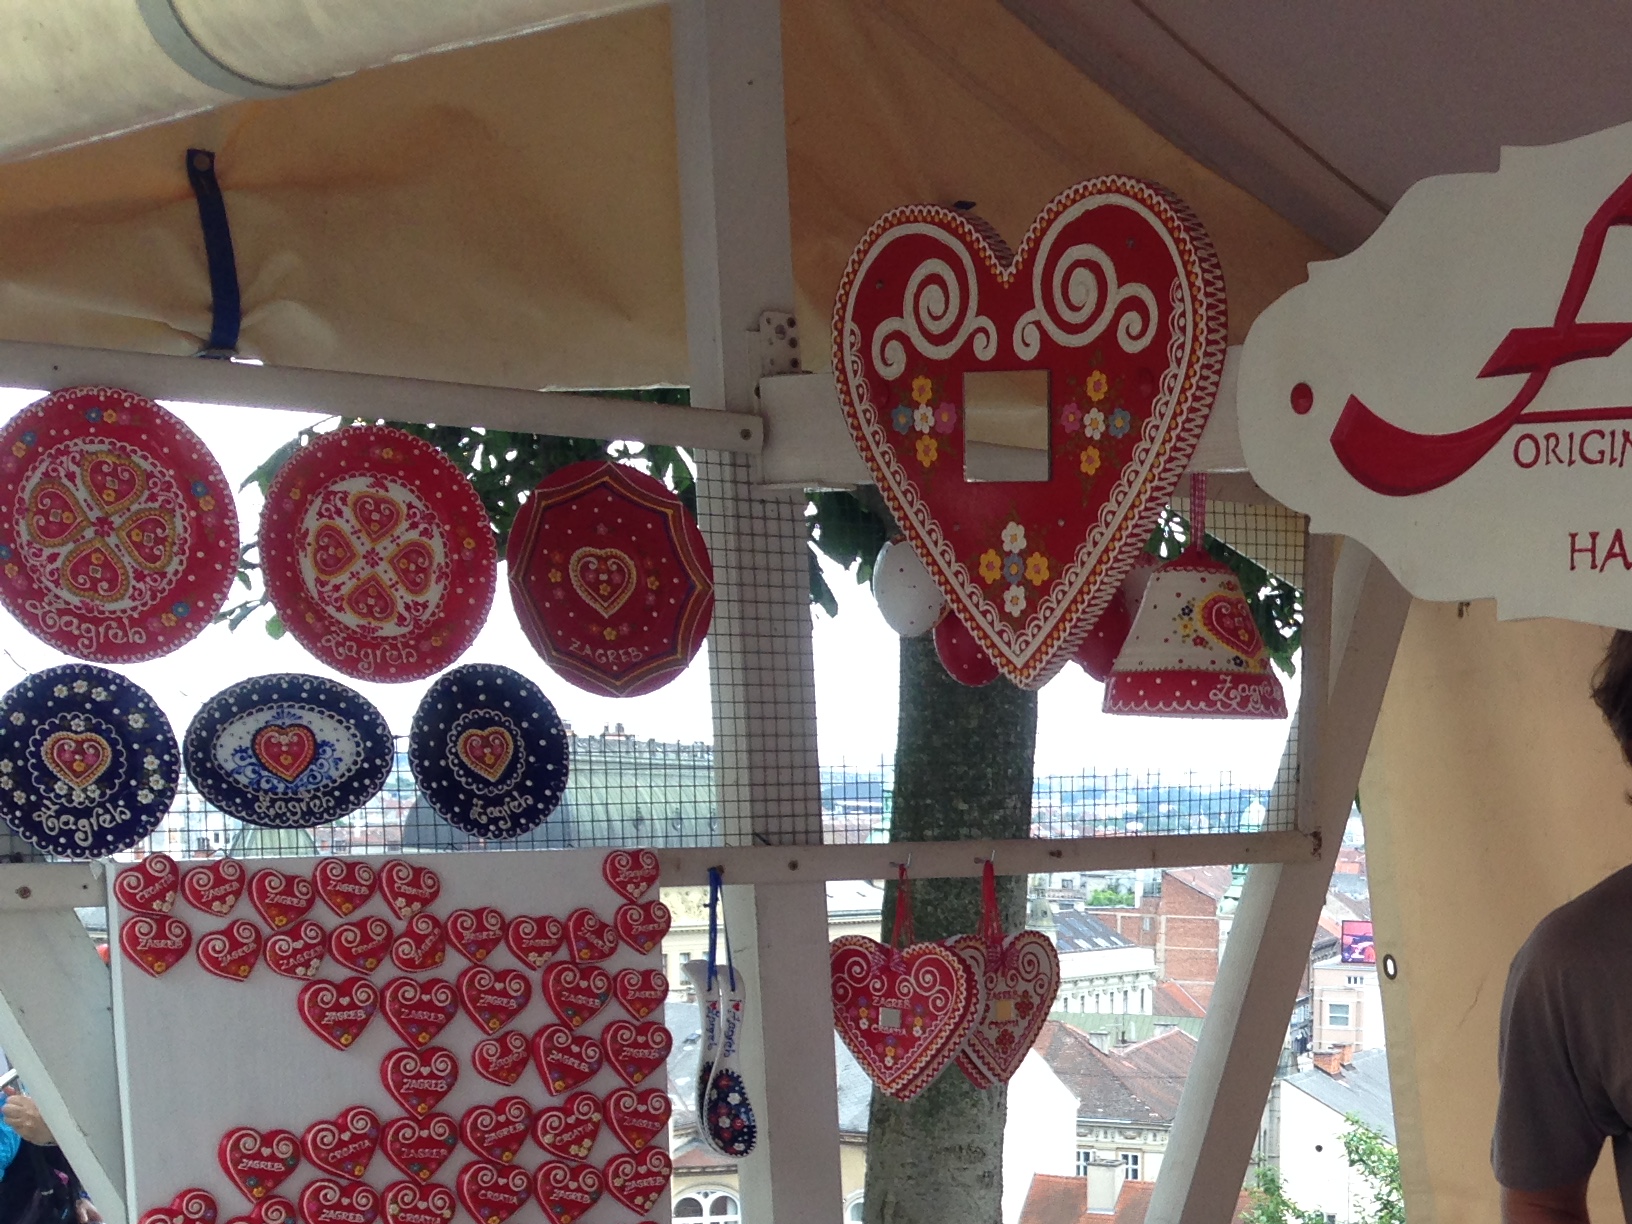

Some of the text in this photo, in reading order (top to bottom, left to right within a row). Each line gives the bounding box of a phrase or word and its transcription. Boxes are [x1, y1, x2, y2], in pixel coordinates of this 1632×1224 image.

[26, 597, 147, 652] Zagreb
[321, 628, 418, 673] Zagreb
[567, 638, 644, 664] ZAGREB
[253, 790, 335, 823] Zagreb
[469, 792, 534, 829] Zagreb
[33, 799, 131, 847] Zagreb
[871, 996, 912, 1009] ZAGREB
[546, 1051, 590, 1073] ZAGREB
[400, 1078, 448, 1093] ZAGREB
[483, 1122, 526, 1146] ZAGREB
[555, 1122, 595, 1146] CROATIA
[328, 1139, 372, 1163] CROATIA
[237, 1158, 285, 1172] ZAGREB
[477, 1190, 518, 1204] CROATIA
[549, 1188, 591, 1204] ZAGREB
[623, 1177, 666, 1194] ZAGREB
[318, 1208, 365, 1224] ZAGREB
